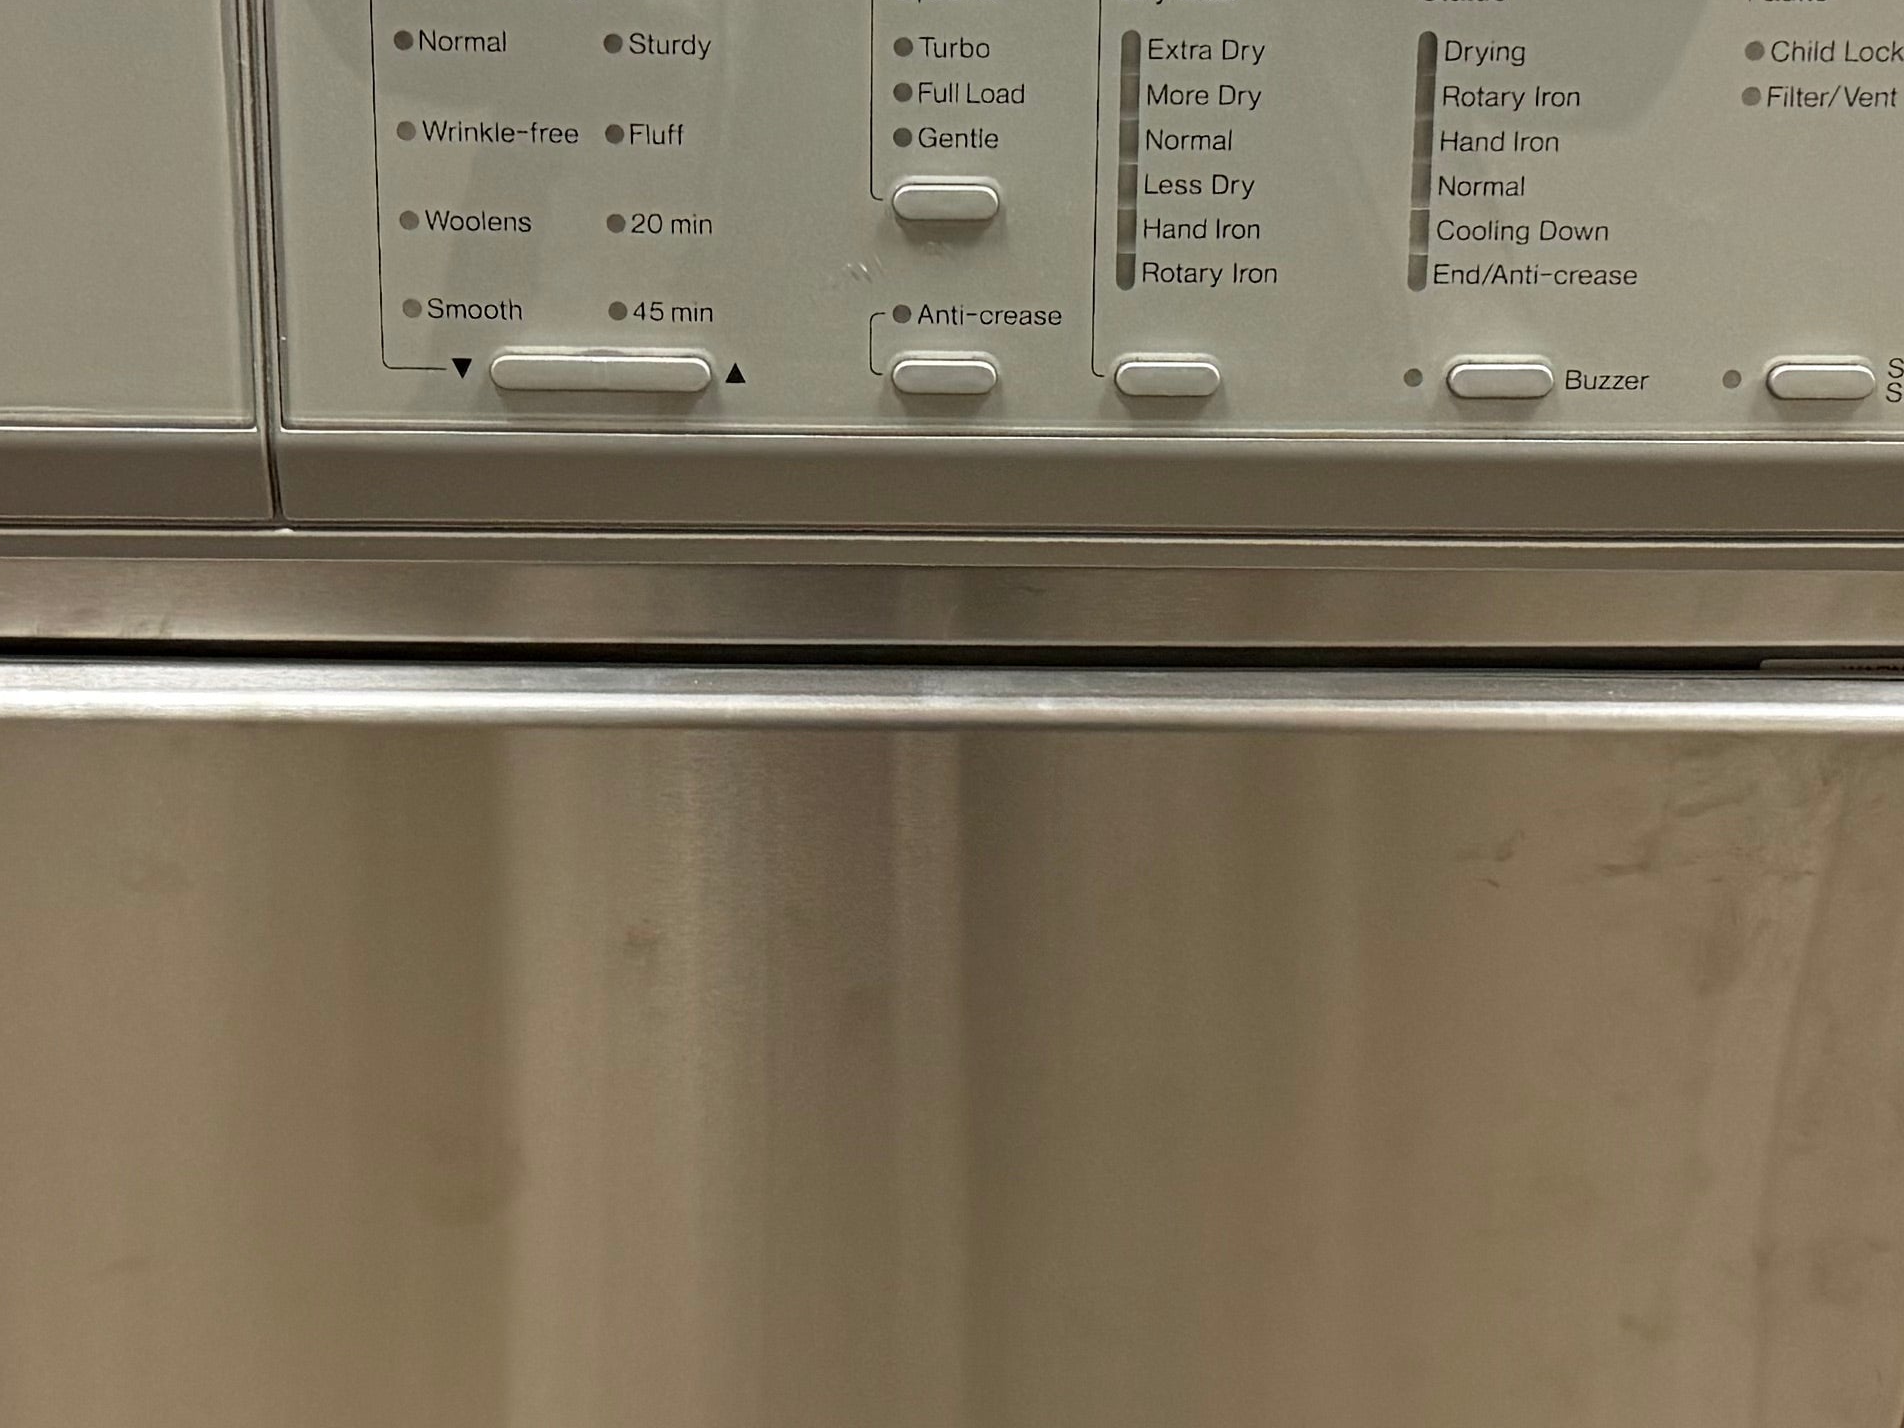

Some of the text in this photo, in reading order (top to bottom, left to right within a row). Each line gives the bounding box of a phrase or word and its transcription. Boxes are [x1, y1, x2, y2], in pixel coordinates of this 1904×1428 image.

[420, 30, 506, 52] Normal
[630, 33, 711, 60] Sturdy
[919, 37, 989, 58] Turbo
[1149, 39, 1265, 65] Extra Dry
[1771, 40, 1835, 62] Child
[1845, 41, 1904, 62] Lock
[1445, 40, 1525, 66] Drying
[919, 82, 1024, 104] Full Load
[1148, 84, 1261, 110] More Dry
[1443, 86, 1579, 111] Rotary Iron
[1768, 85, 1896, 107] Filter/Vent
[423, 121, 578, 143] Wrinkle-free
[630, 124, 683, 145] Fluff
[919, 127, 998, 148] Gentle
[1147, 129, 1232, 150] Normal
[1441, 131, 1558, 152] Hand Iron
[1145, 174, 1254, 199] Less Dry
[1439, 176, 1524, 196] Normal
[425, 210, 531, 232] Woolens
[632, 213, 712, 234] 20 min
[1144, 218, 1259, 239] Hand Iron
[1437, 220, 1608, 245] Cooling Down
[1143, 262, 1277, 287] Rotary Iron
[1434, 264, 1637, 285] End/Anti-crease
[428, 298, 522, 320] Smooth
[633, 302, 712, 322] 45 min
[918, 304, 1061, 325] Anti-crease
[1566, 370, 1649, 390] Buzzer
